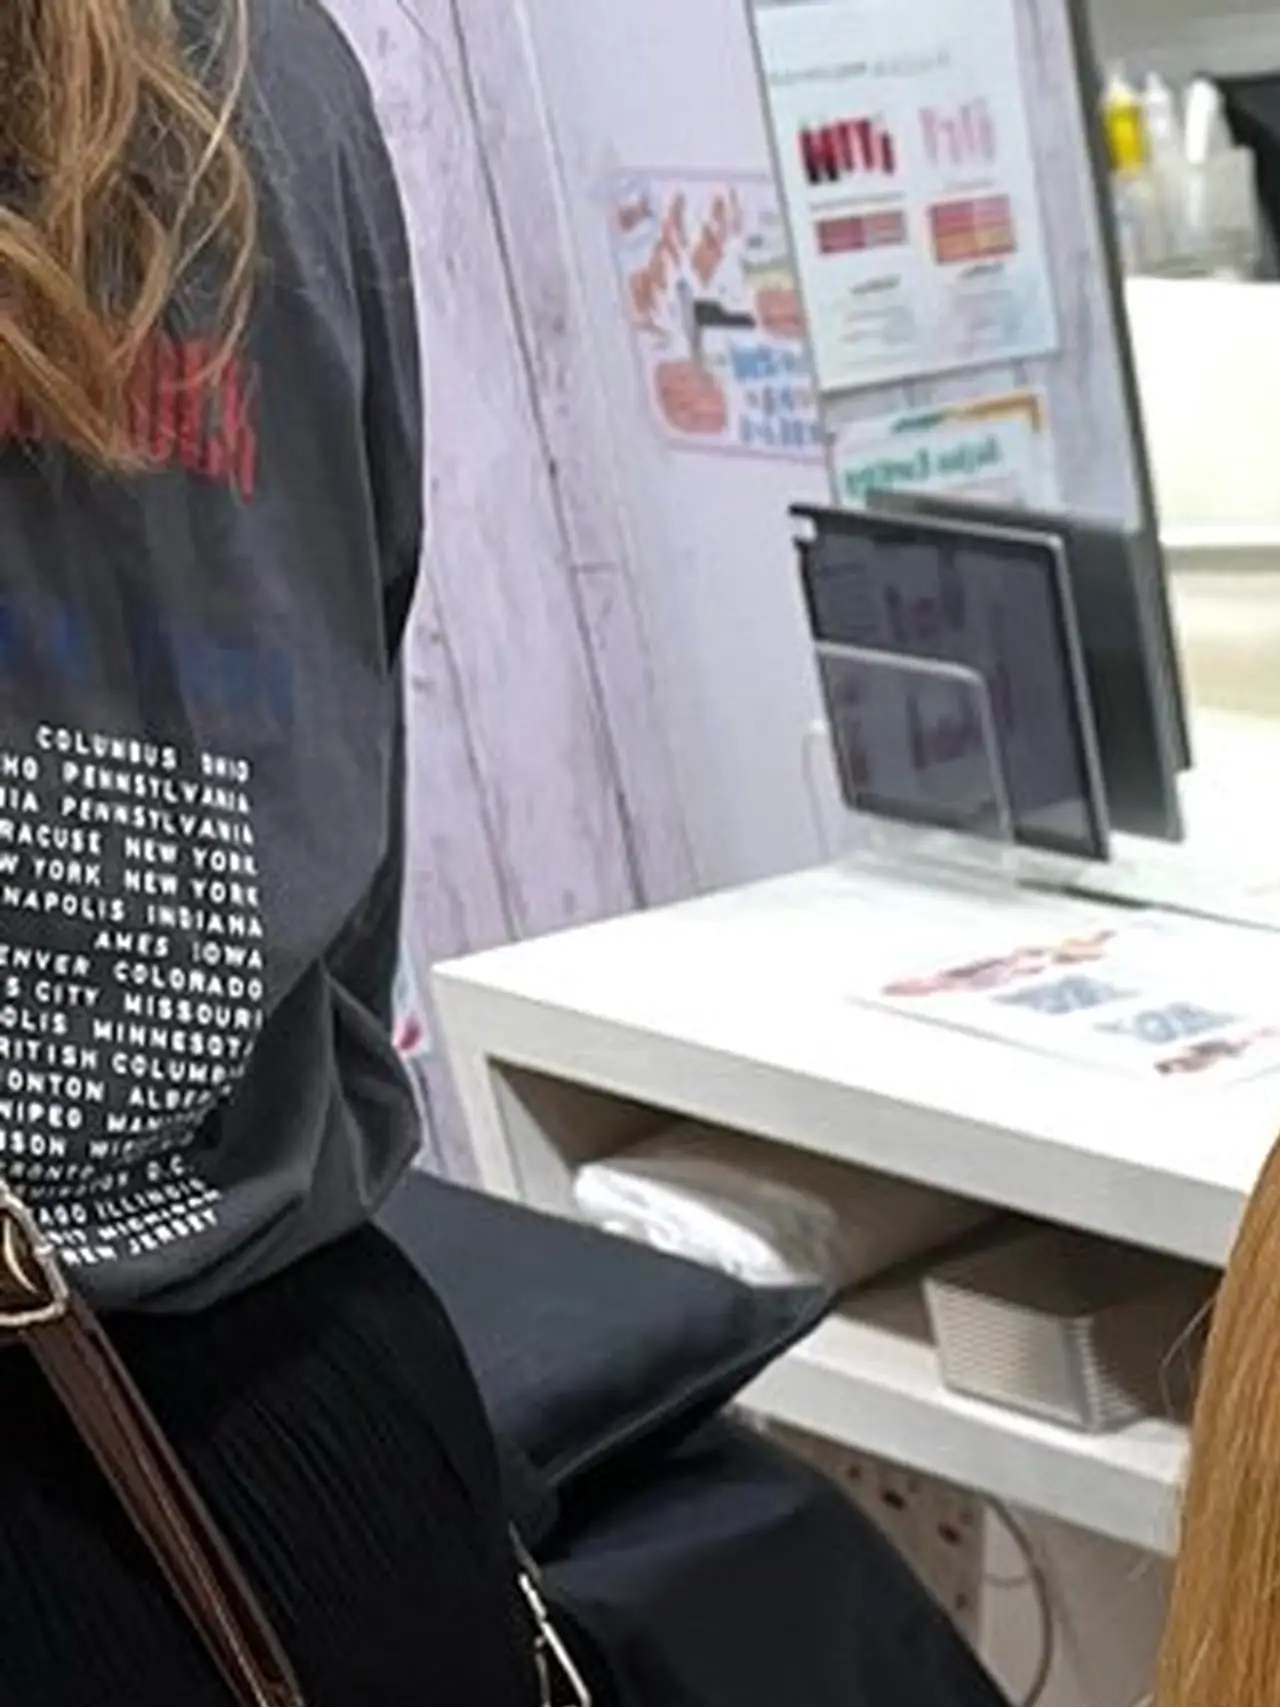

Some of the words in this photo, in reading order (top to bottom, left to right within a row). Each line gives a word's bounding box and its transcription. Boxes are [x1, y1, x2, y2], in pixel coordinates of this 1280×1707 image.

[37, 725, 176, 771] COLUMBUS
[62, 761, 249, 814] PENNSYLVANIA
[61, 796, 254, 846] PENNSYLVANIA
[124, 836, 177, 863] NEW
[192, 846, 258, 877] YORK
[33, 857, 100, 888] YORK
[124, 868, 178, 896] NEW
[190, 878, 258, 908] YORK
[148, 904, 262, 938] INDIANA
[94, 930, 168, 958] AMES
[193, 940, 262, 970] IOWA
[113, 960, 262, 999] COLORADO
[34, 980, 101, 1008] CITY
[124, 992, 262, 1030] MISSOURI
